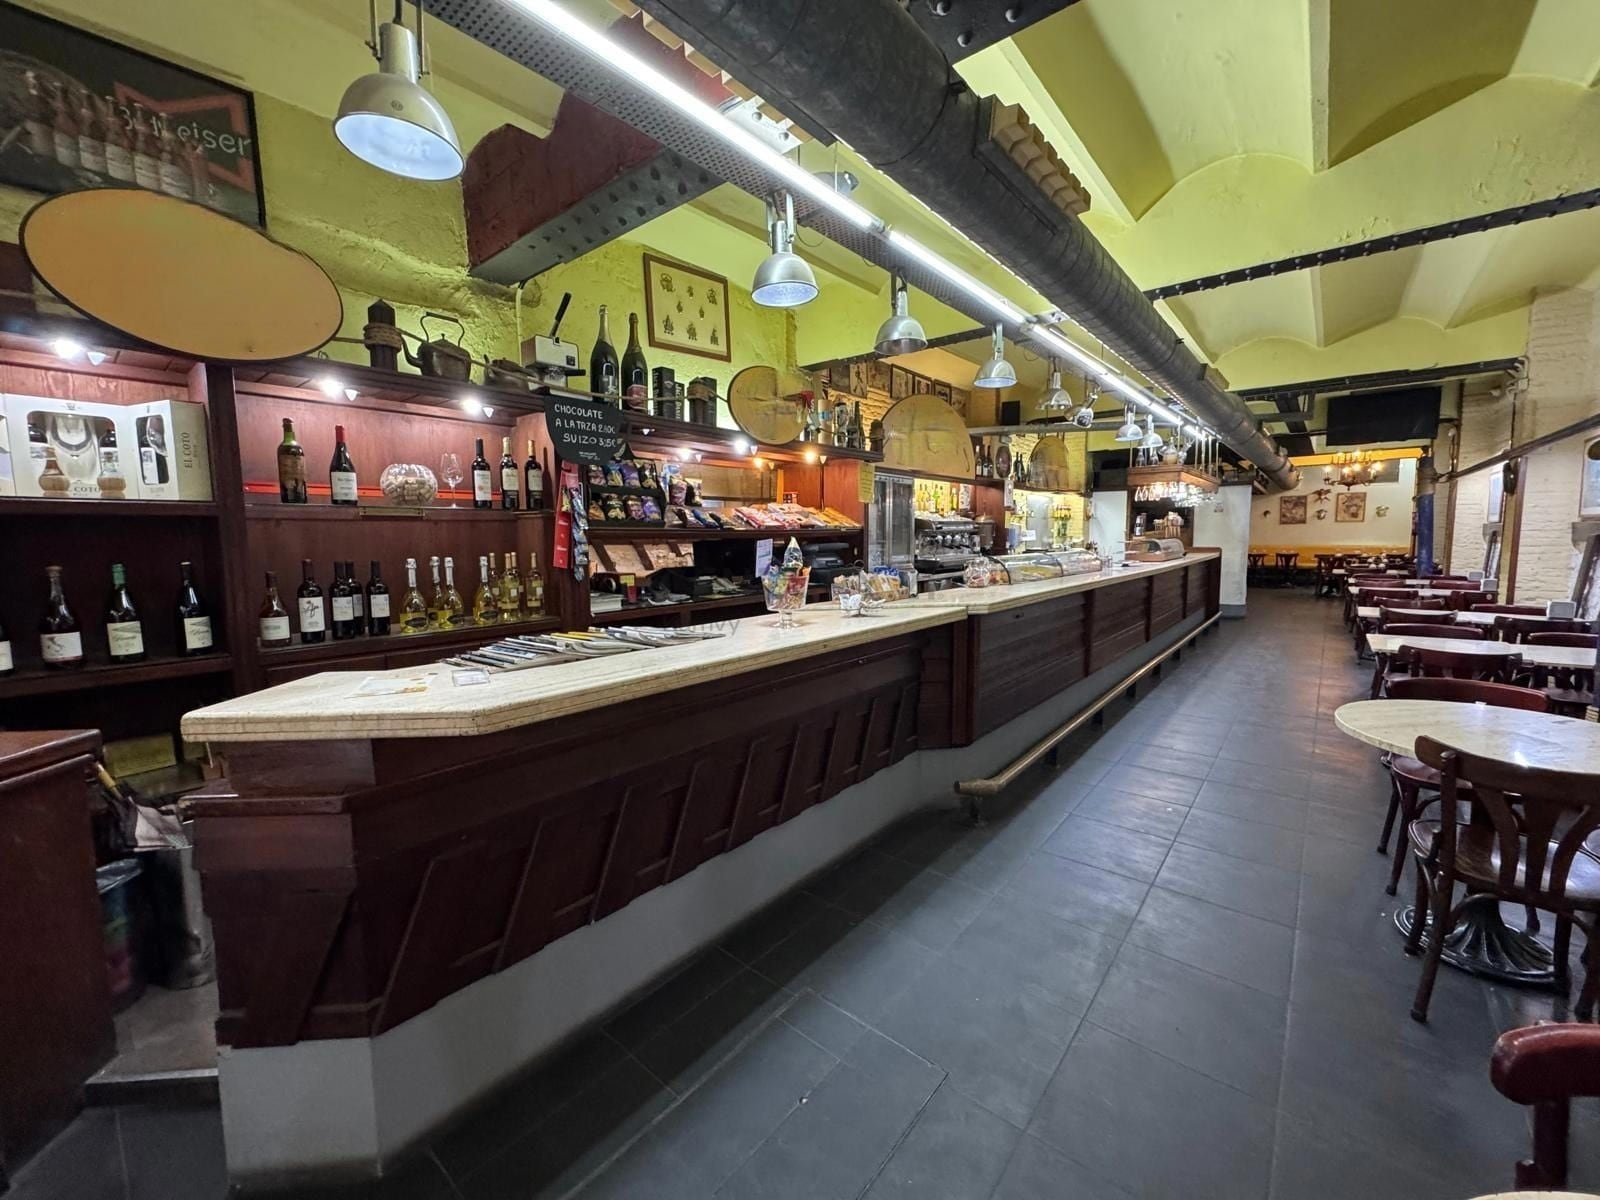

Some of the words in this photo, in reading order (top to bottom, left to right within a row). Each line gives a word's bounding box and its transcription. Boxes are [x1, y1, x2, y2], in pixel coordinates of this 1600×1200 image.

[554, 403, 604, 419] CHOCOLATE
[555, 418, 562, 427] A
[564, 419, 576, 429] LA
[181, 432, 192, 456] COTO
[563, 433, 597, 445] SUIZO
